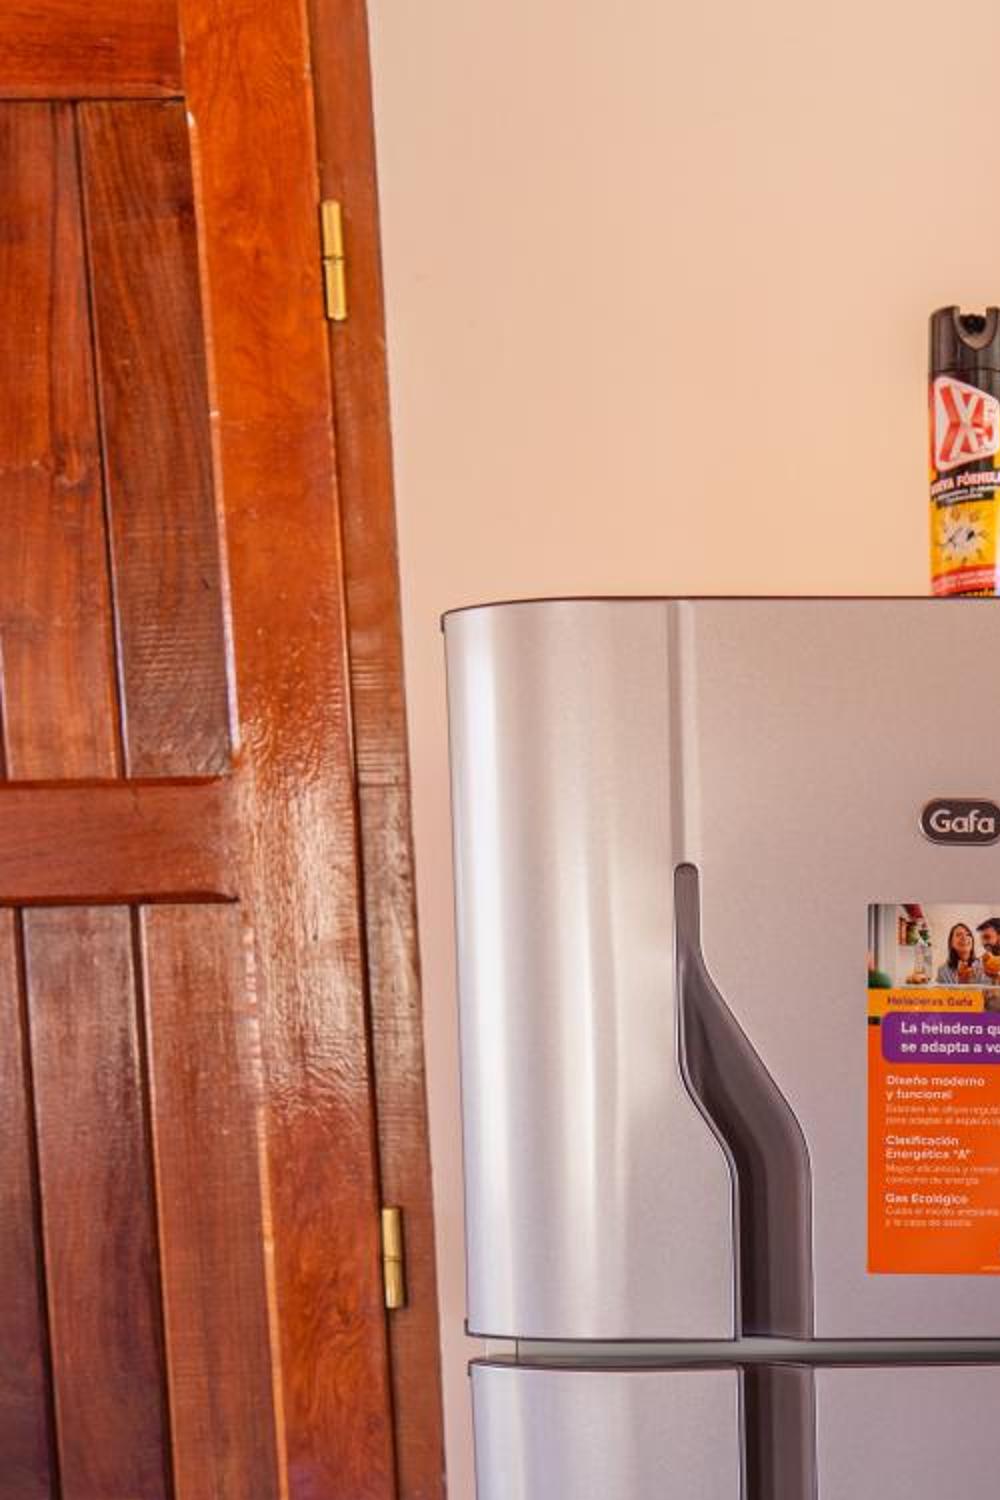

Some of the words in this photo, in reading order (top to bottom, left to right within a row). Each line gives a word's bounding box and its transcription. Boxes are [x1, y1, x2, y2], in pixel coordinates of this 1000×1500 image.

[929, 809, 995, 833] Gafa
[900, 1021, 918, 1035] La
[921, 1021, 984, 1036] heladera
[900, 1043, 917, 1054] se
[920, 1041, 970, 1056] adapta
[973, 1044, 983, 1054] a
[886, 1074, 930, 1087] Diseño
[931, 1074, 986, 1088] moderno
[886, 1090, 894, 1101] y
[896, 1087, 953, 1100] funcional
[885, 1134, 960, 1146] Clasificación
[885, 1148, 950, 1161] Energética
[884, 1193, 909, 1205] Gas
[911, 1192, 970, 1207] Ecológico
